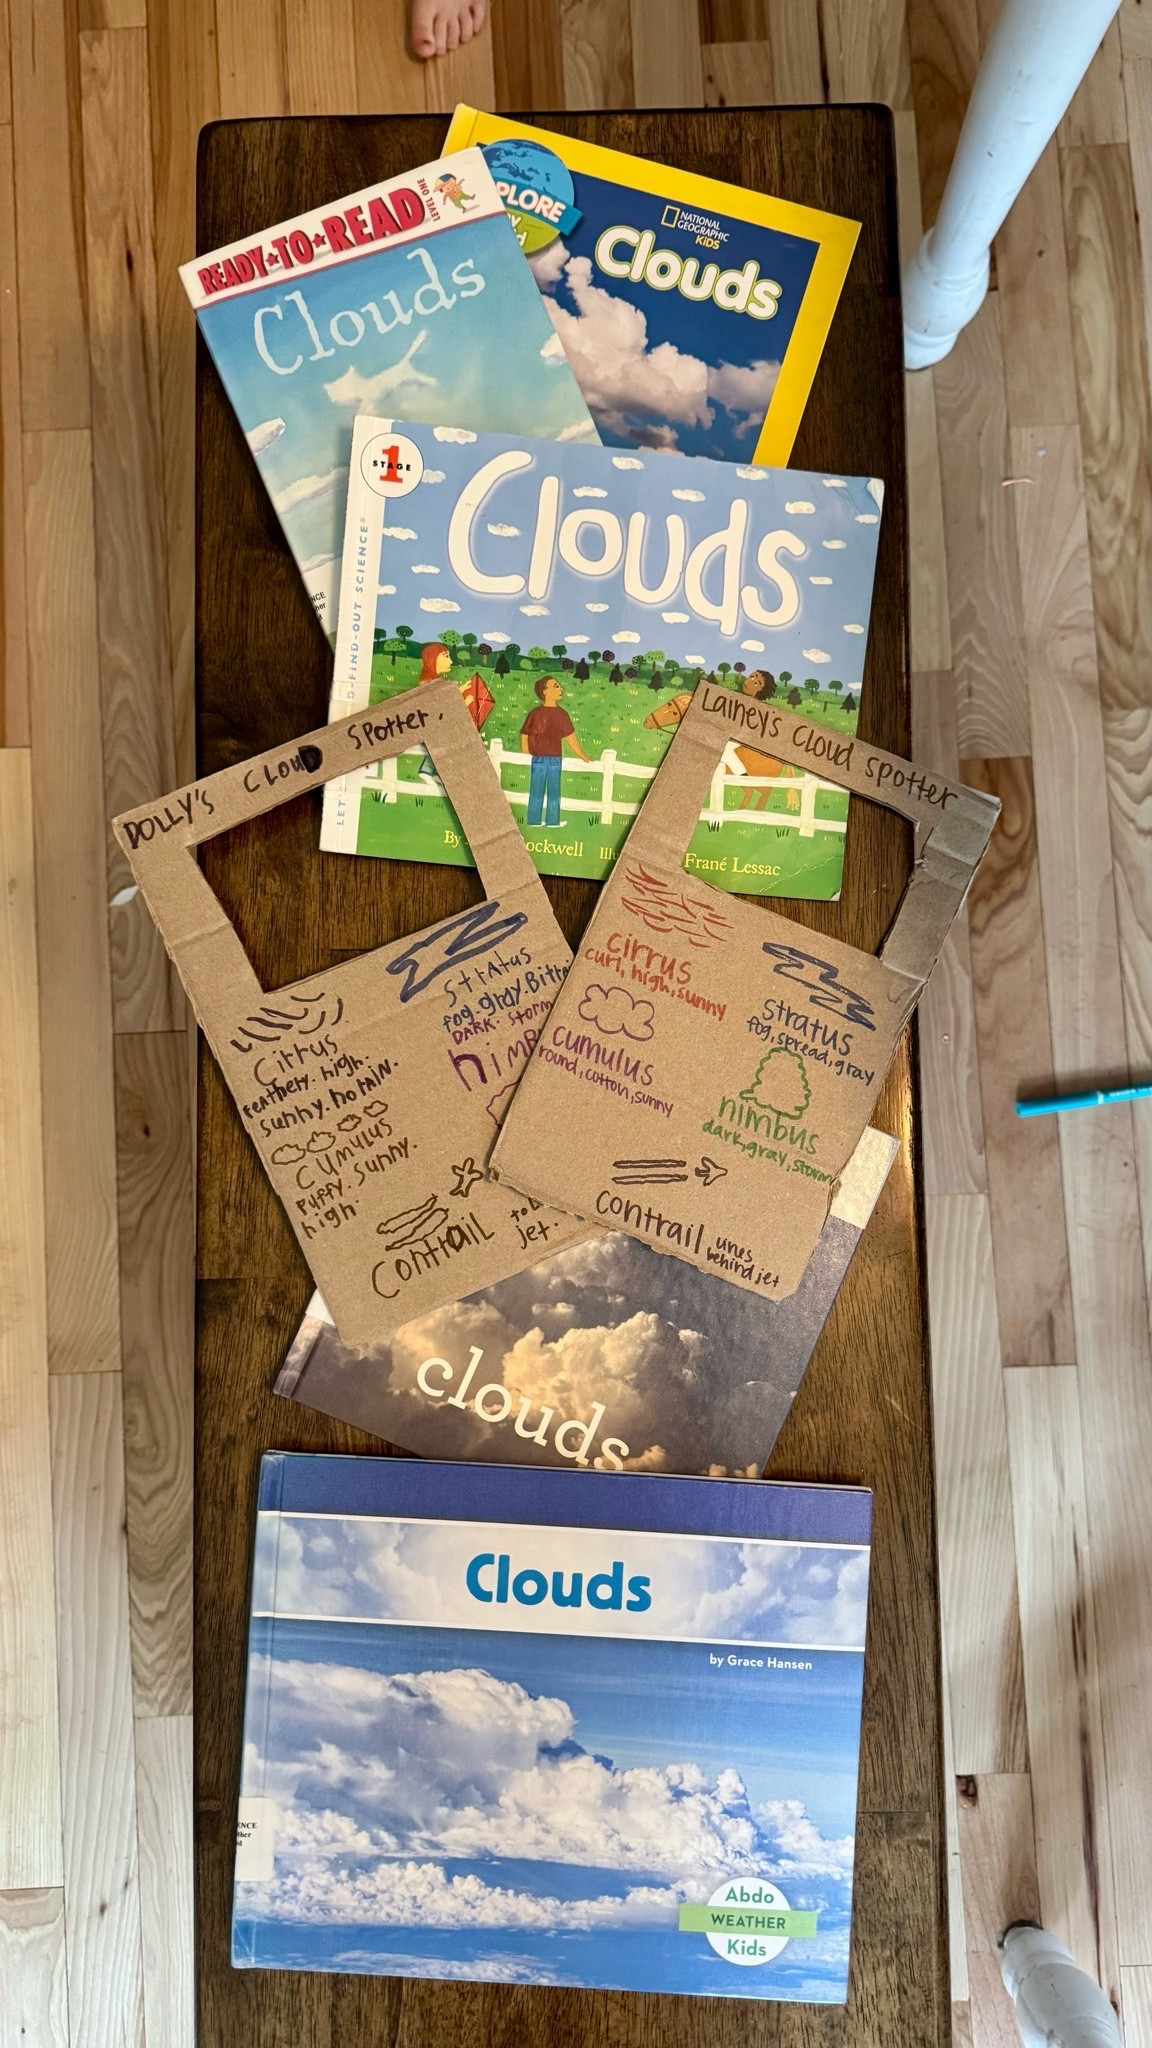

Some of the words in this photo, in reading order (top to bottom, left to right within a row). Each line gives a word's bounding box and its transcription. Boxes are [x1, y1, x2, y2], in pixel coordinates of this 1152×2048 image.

[416, 177, 430, 197] ONE
[496, 181, 566, 223] PLORE
[320, 187, 427, 253] READ
[423, 195, 441, 222] LEVEL
[680, 211, 721, 231] NATIONAL
[677, 220, 730, 243] GEOGRAPHIC
[594, 224, 782, 320] Clouds
[253, 247, 486, 375] Clouds
[372, 459, 412, 472] STAGE
[379, 444, 403, 484] 1
[447, 450, 808, 637] Clouds
[702, 687, 783, 739] Lainey's
[444, 830, 462, 846] By
[525, 838, 584, 857] ockwell
[684, 853, 728, 873] Frané
[733, 856, 781, 877] Lessac
[676, 986, 727, 1022] sunny
[834, 1058, 875, 1087] gray
[634, 1091, 674, 1119] sunny
[718, 1095, 820, 1155] nimbus
[706, 1246, 755, 1281] behind
[754, 1267, 780, 1288] jet
[416, 1345, 630, 1472] clouds
[465, 1552, 652, 1613] Clouds
[708, 1652, 724, 1668] by
[727, 1654, 764, 1668] Grace
[767, 1656, 813, 1670] Hansen
[725, 1885, 774, 1904] Abdo
[711, 1913, 786, 1929] WEATHER
[727, 1938, 767, 1957] Kids
